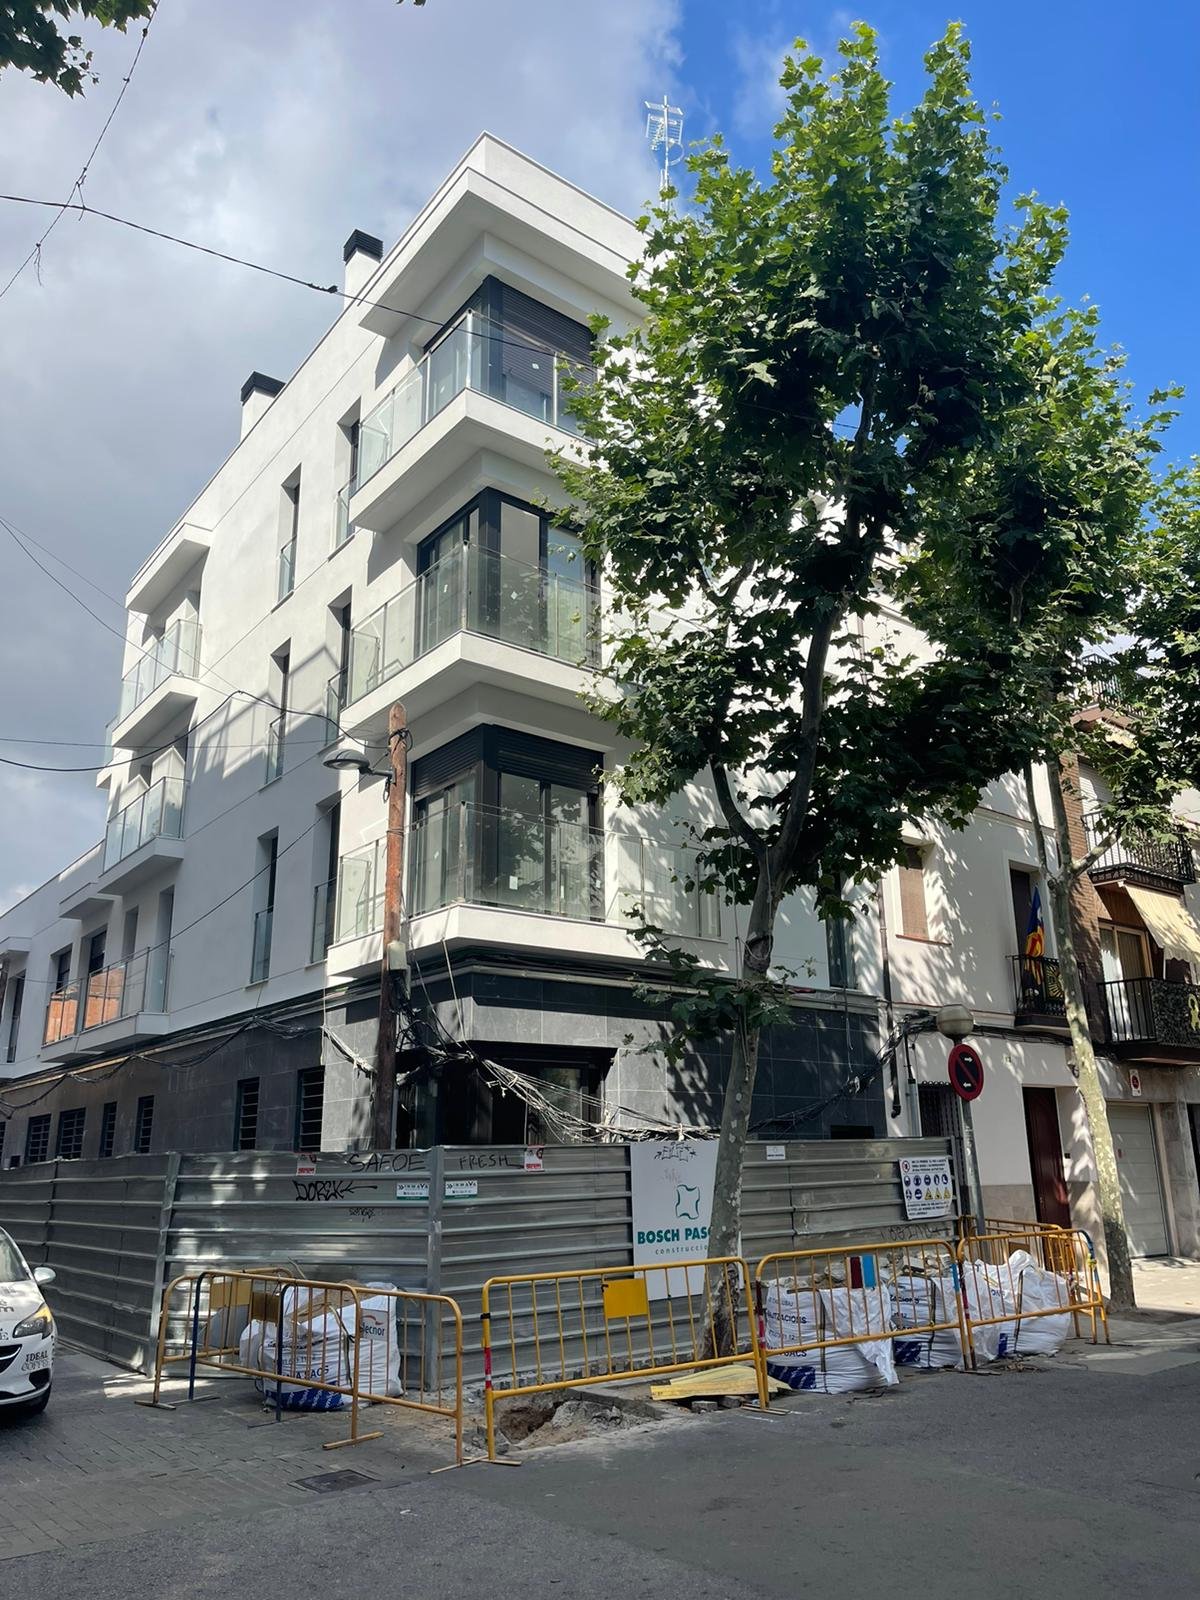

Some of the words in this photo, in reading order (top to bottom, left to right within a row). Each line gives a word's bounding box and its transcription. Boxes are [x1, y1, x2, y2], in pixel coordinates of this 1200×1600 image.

[459, 1154, 510, 1170] FRESH
[637, 1228, 680, 1245] BOSCH
[26, 1350, 48, 1362] IDEAL
